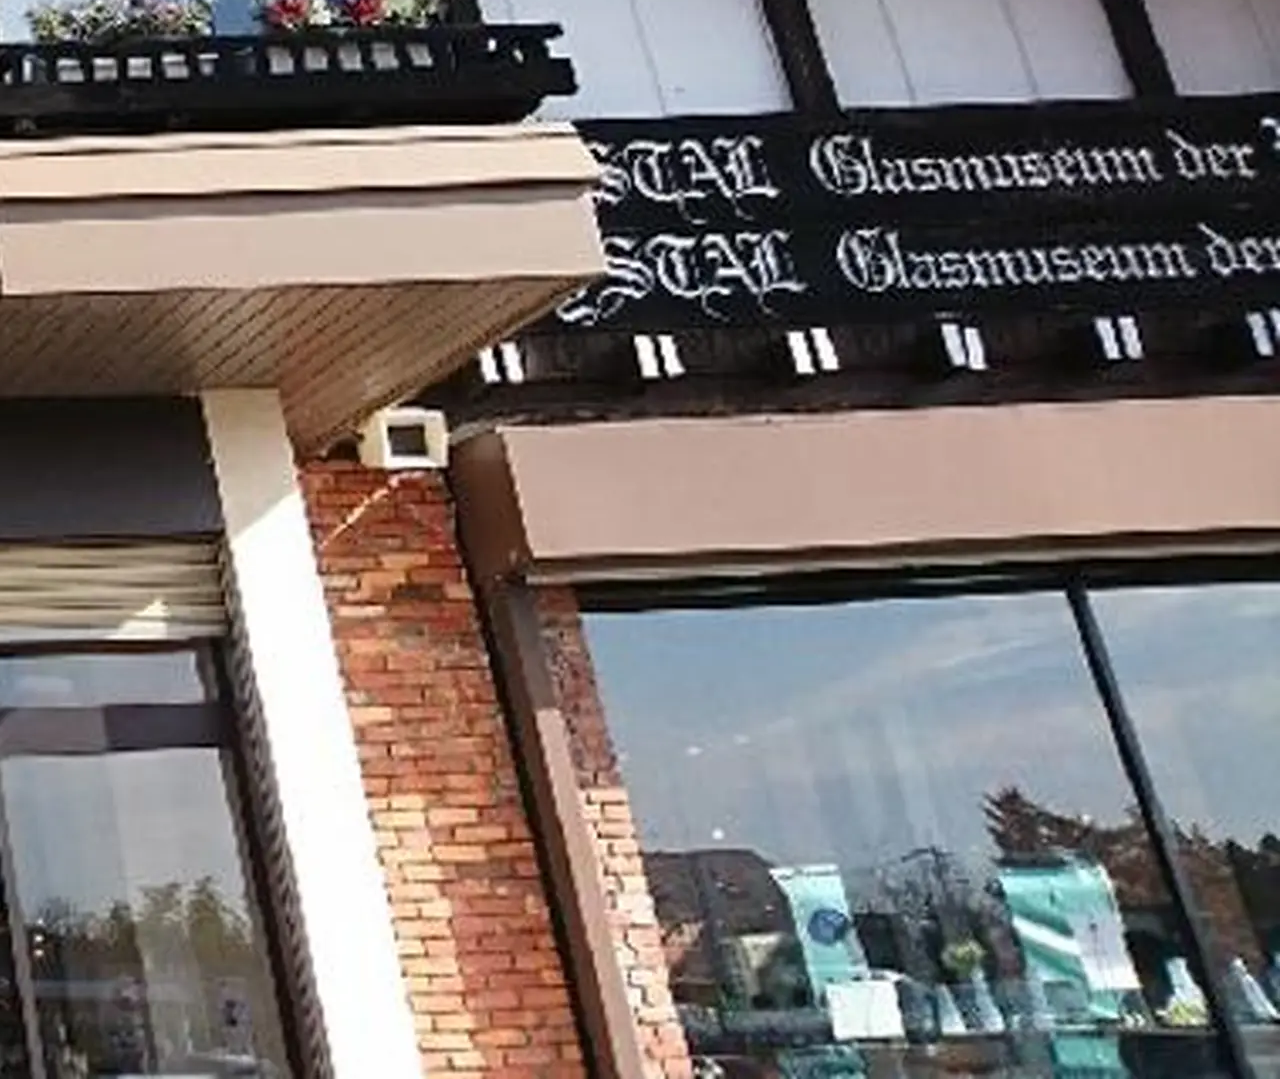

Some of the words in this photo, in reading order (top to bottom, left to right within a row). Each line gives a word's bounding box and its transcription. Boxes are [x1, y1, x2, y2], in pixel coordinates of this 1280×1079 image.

[809, 134, 1165, 197] Glasmuseum
[1165, 127, 1259, 180] der
[836, 225, 1198, 294] Glasmuseum
